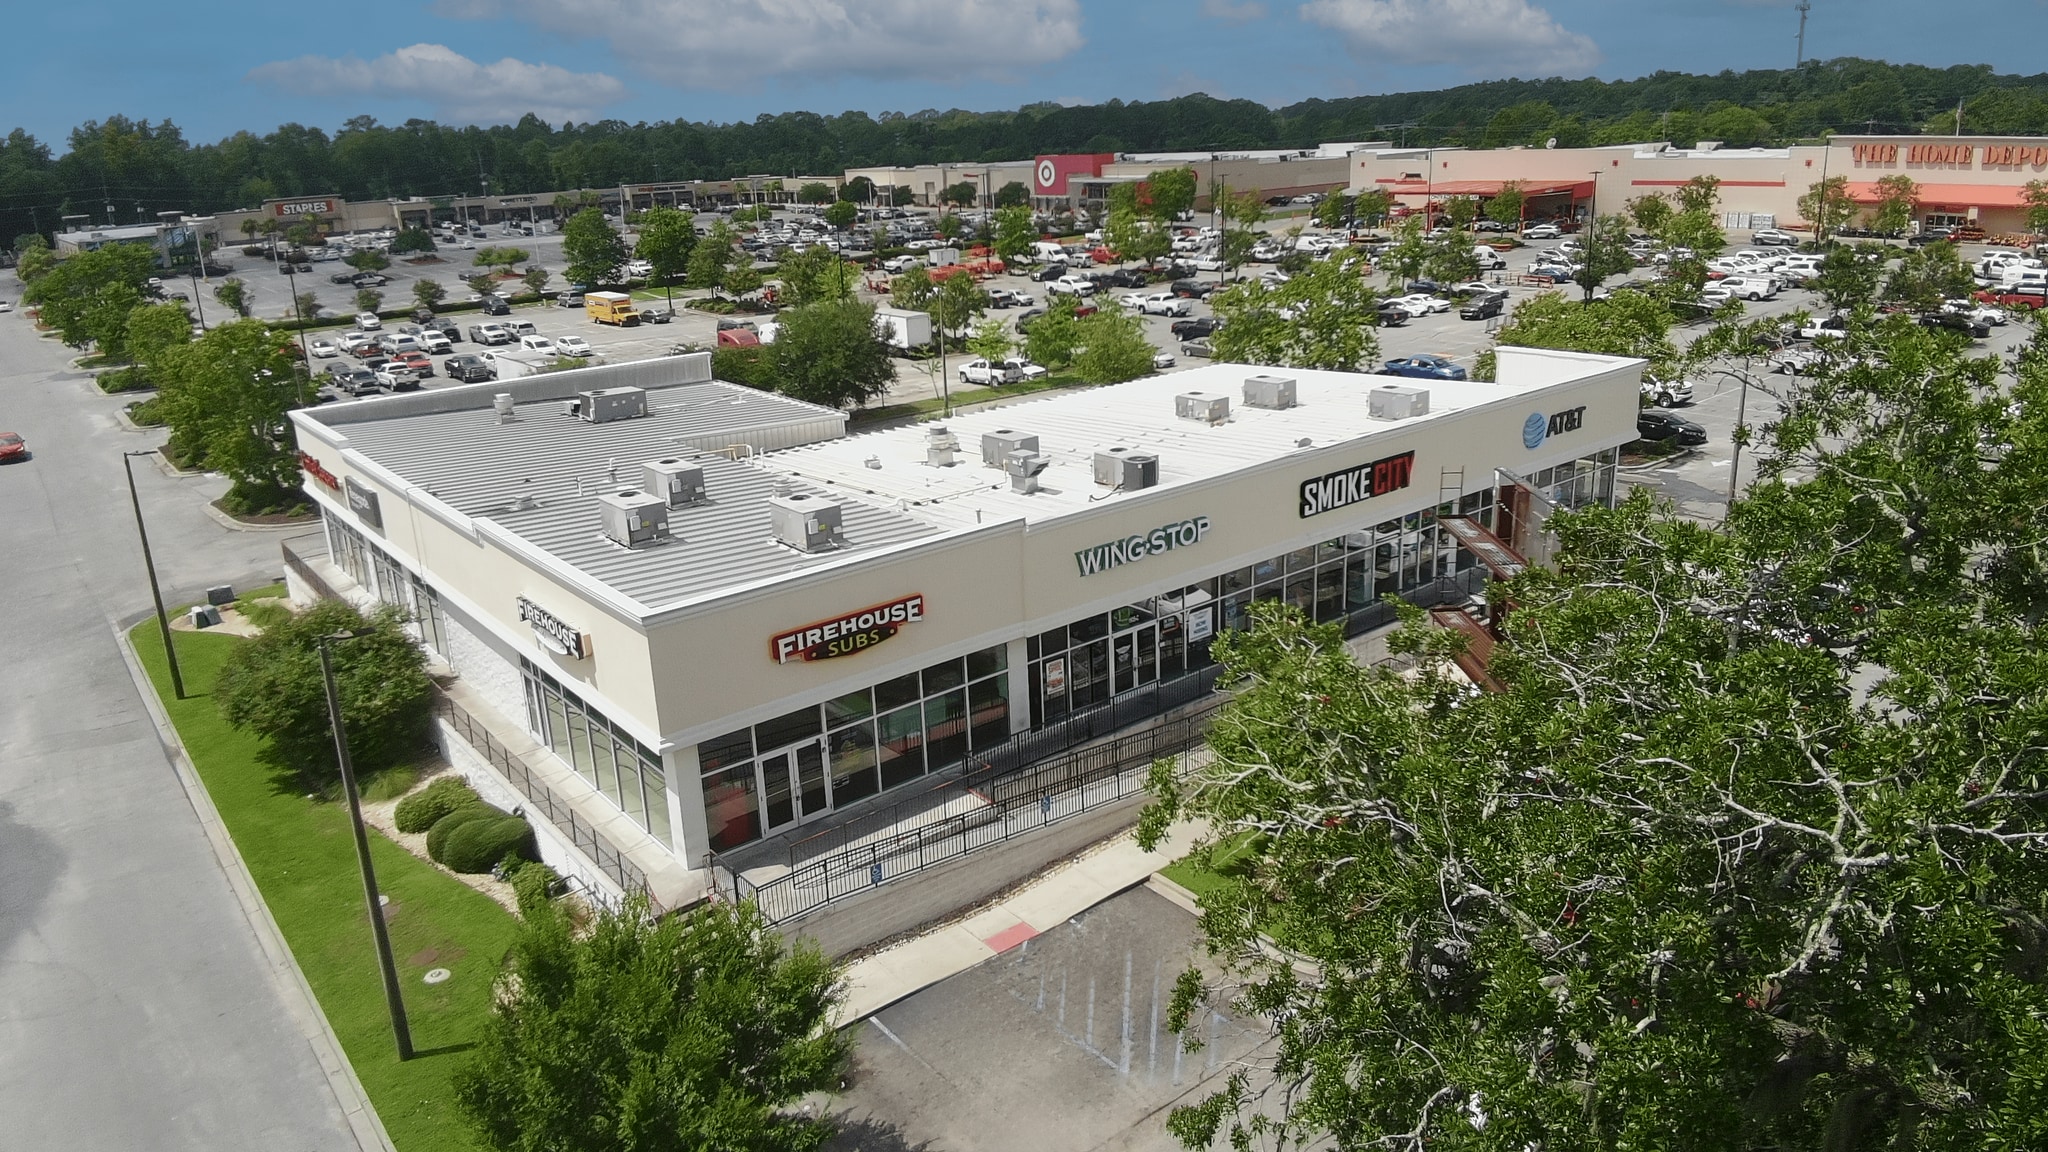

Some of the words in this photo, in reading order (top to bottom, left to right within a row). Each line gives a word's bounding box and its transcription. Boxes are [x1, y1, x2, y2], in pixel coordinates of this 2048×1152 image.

[1853, 144, 1898, 163] THE
[1906, 144, 1974, 165] HOME
[282, 202, 328, 215] STAPLES
[1545, 405, 1587, 438] AT&T
[1303, 466, 1372, 517] SMOKE
[1373, 455, 1415, 496] CITY
[516, 598, 581, 661] FIREHOUSE
[777, 597, 923, 665] FIREHOUSE
[827, 628, 880, 657] SUBS
